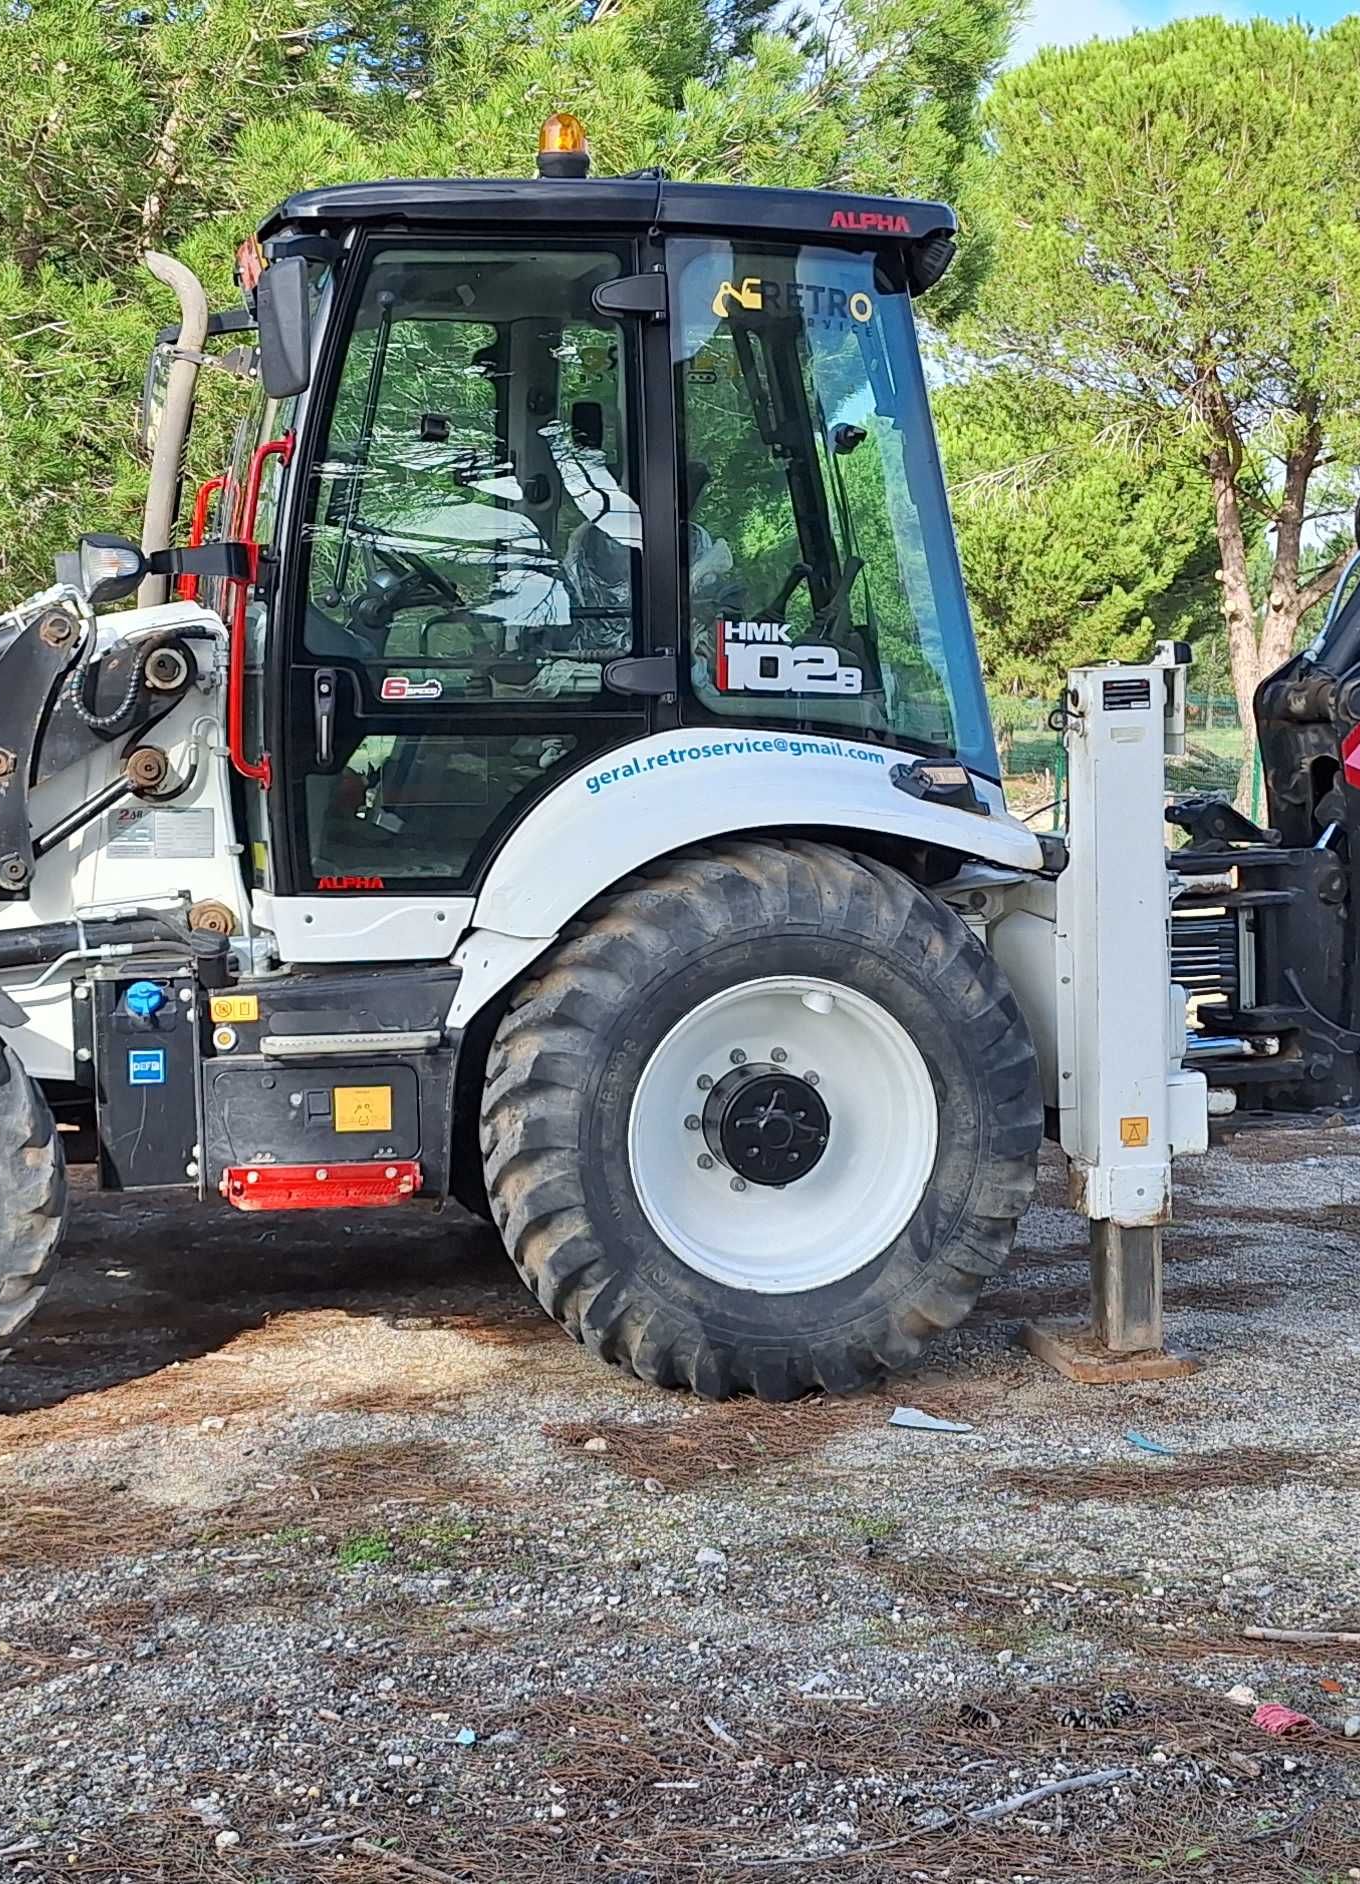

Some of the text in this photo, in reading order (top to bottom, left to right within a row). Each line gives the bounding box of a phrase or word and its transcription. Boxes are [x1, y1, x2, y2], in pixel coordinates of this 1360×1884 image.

[830, 211, 911, 233] ALPHA
[760, 279, 873, 323] RETRO
[724, 621, 792, 643] HMK
[724, 641, 863, 695] 102B
[382, 677, 409, 699] 6
[585, 736, 886, 795] geral.retroservice@gmail.com
[317, 875, 384, 889] ALPHA
